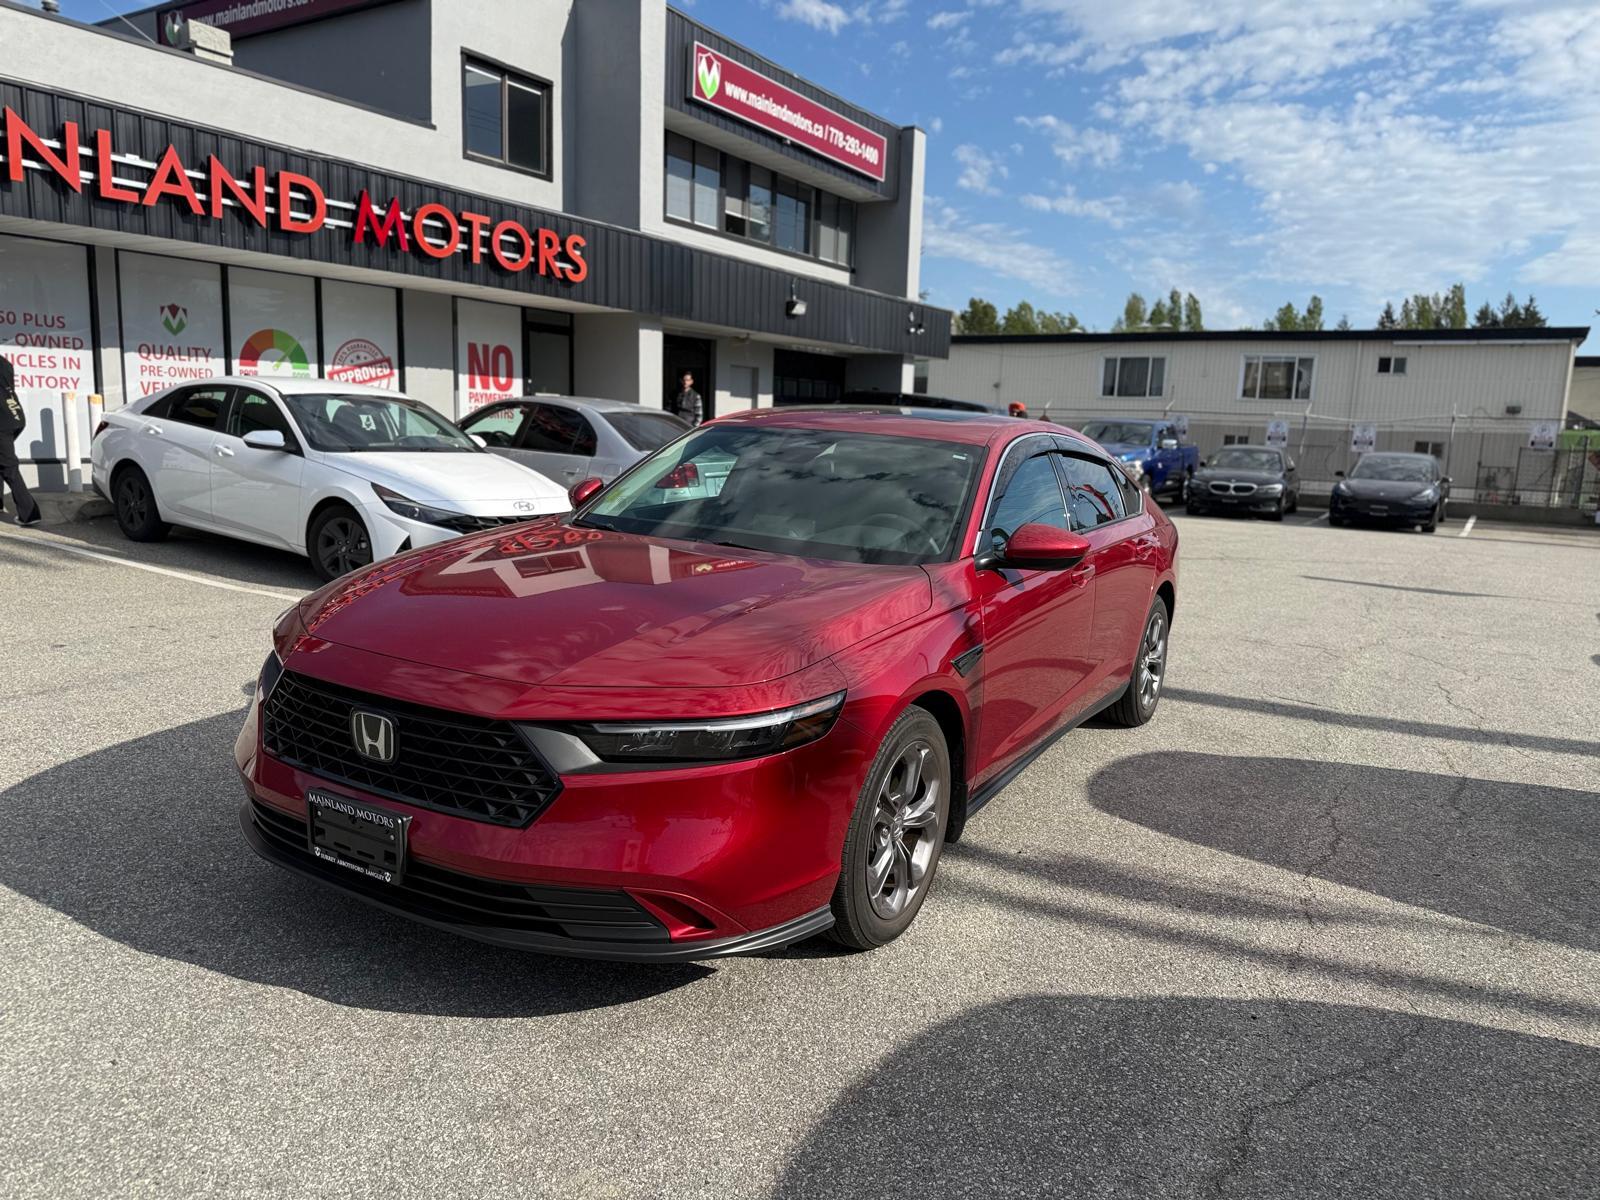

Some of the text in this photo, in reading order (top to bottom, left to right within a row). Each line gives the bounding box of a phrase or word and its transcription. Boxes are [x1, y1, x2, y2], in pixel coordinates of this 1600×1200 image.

[354, 187, 588, 283] MOTORS
[23, 312, 66, 329] PLUS
[15, 332, 84, 350] OWNED
[138, 343, 211, 362] QUALITY
[62, 356, 81, 370] IN
[140, 365, 214, 379] PRE-OWNED
[333, 362, 391, 382] APPROVED
[467, 342, 514, 392] NO
[308, 792, 394, 828] MAINLAND MOTORS
